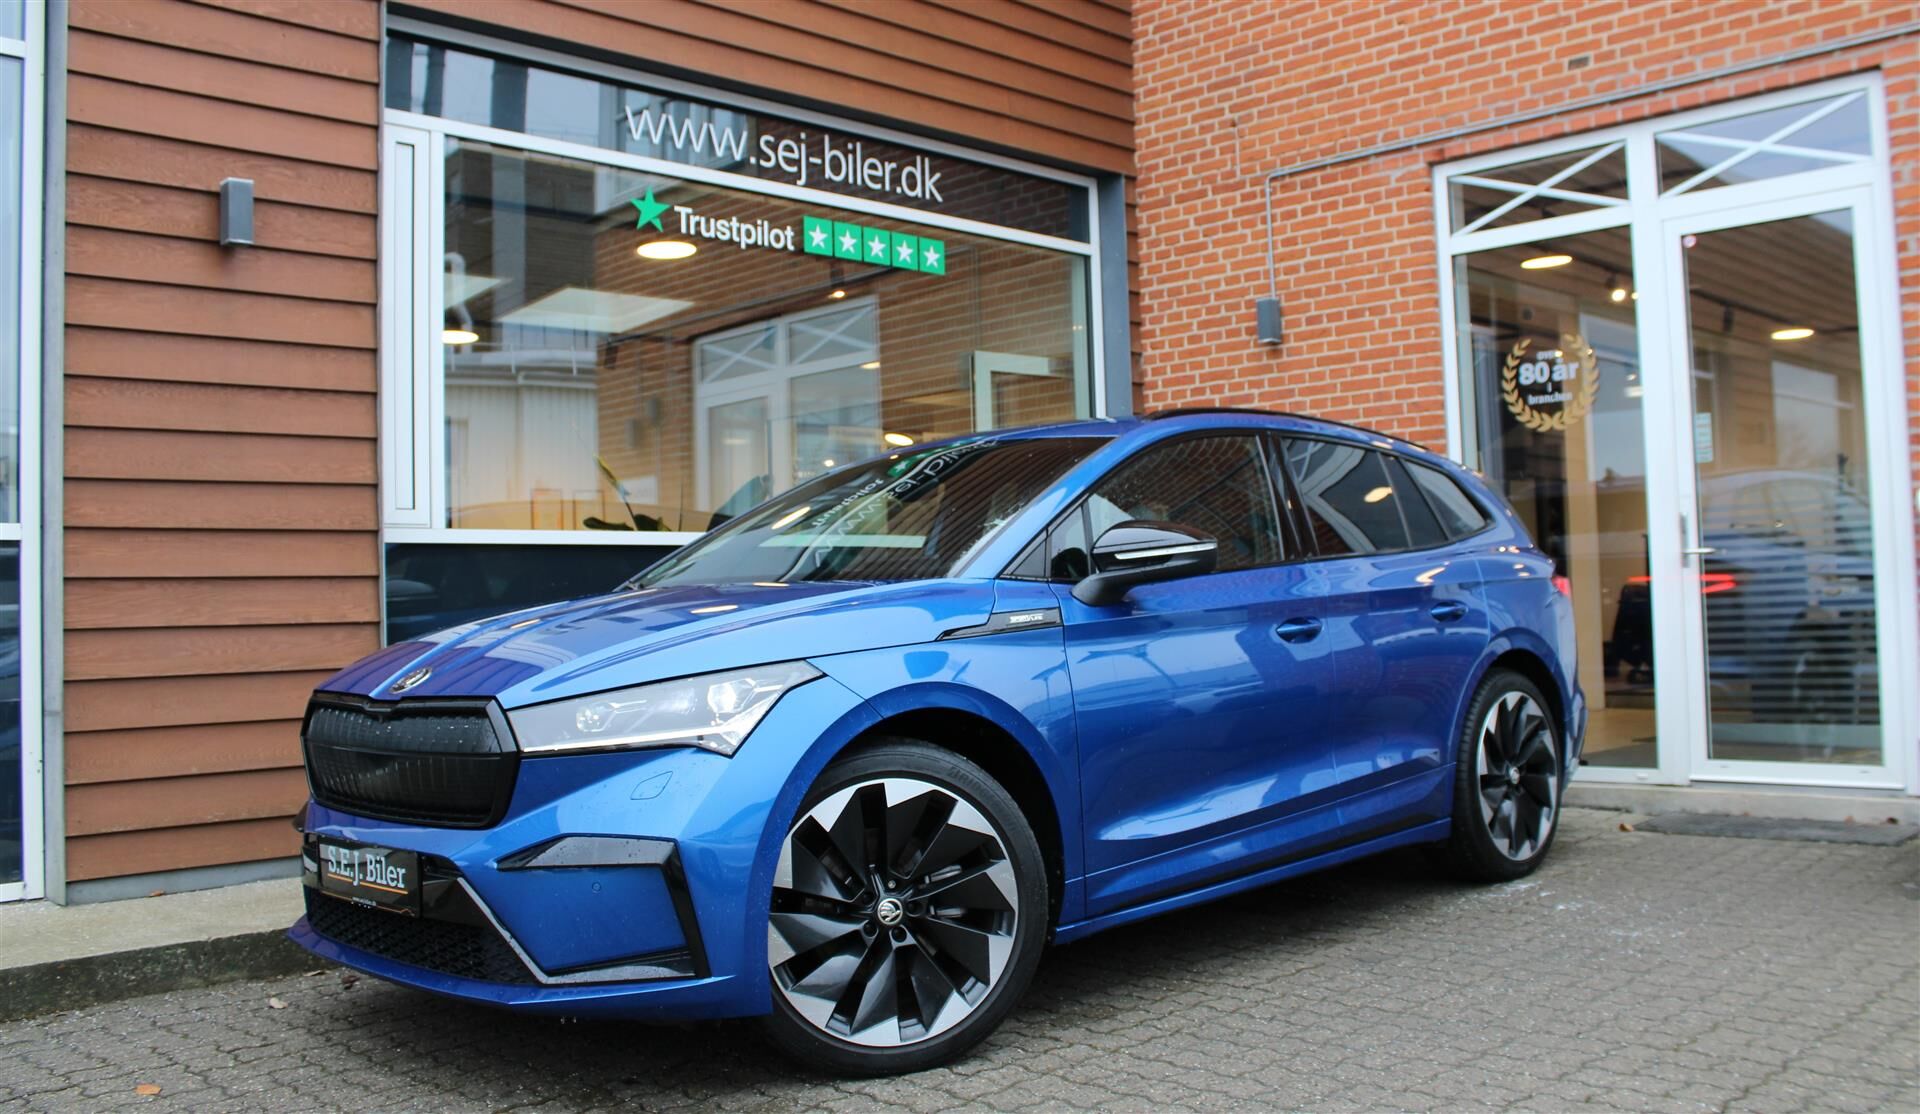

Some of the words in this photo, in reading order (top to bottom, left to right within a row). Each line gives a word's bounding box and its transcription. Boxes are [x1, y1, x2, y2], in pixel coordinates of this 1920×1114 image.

[625, 105, 943, 202] www.sej-biler.dk
[674, 205, 795, 250] Trustpilot
[1518, 361, 1550, 386] 80
[1552, 358, 1579, 381] år
[327, 845, 363, 886] S.E.J.
[366, 853, 406, 888] Biler
